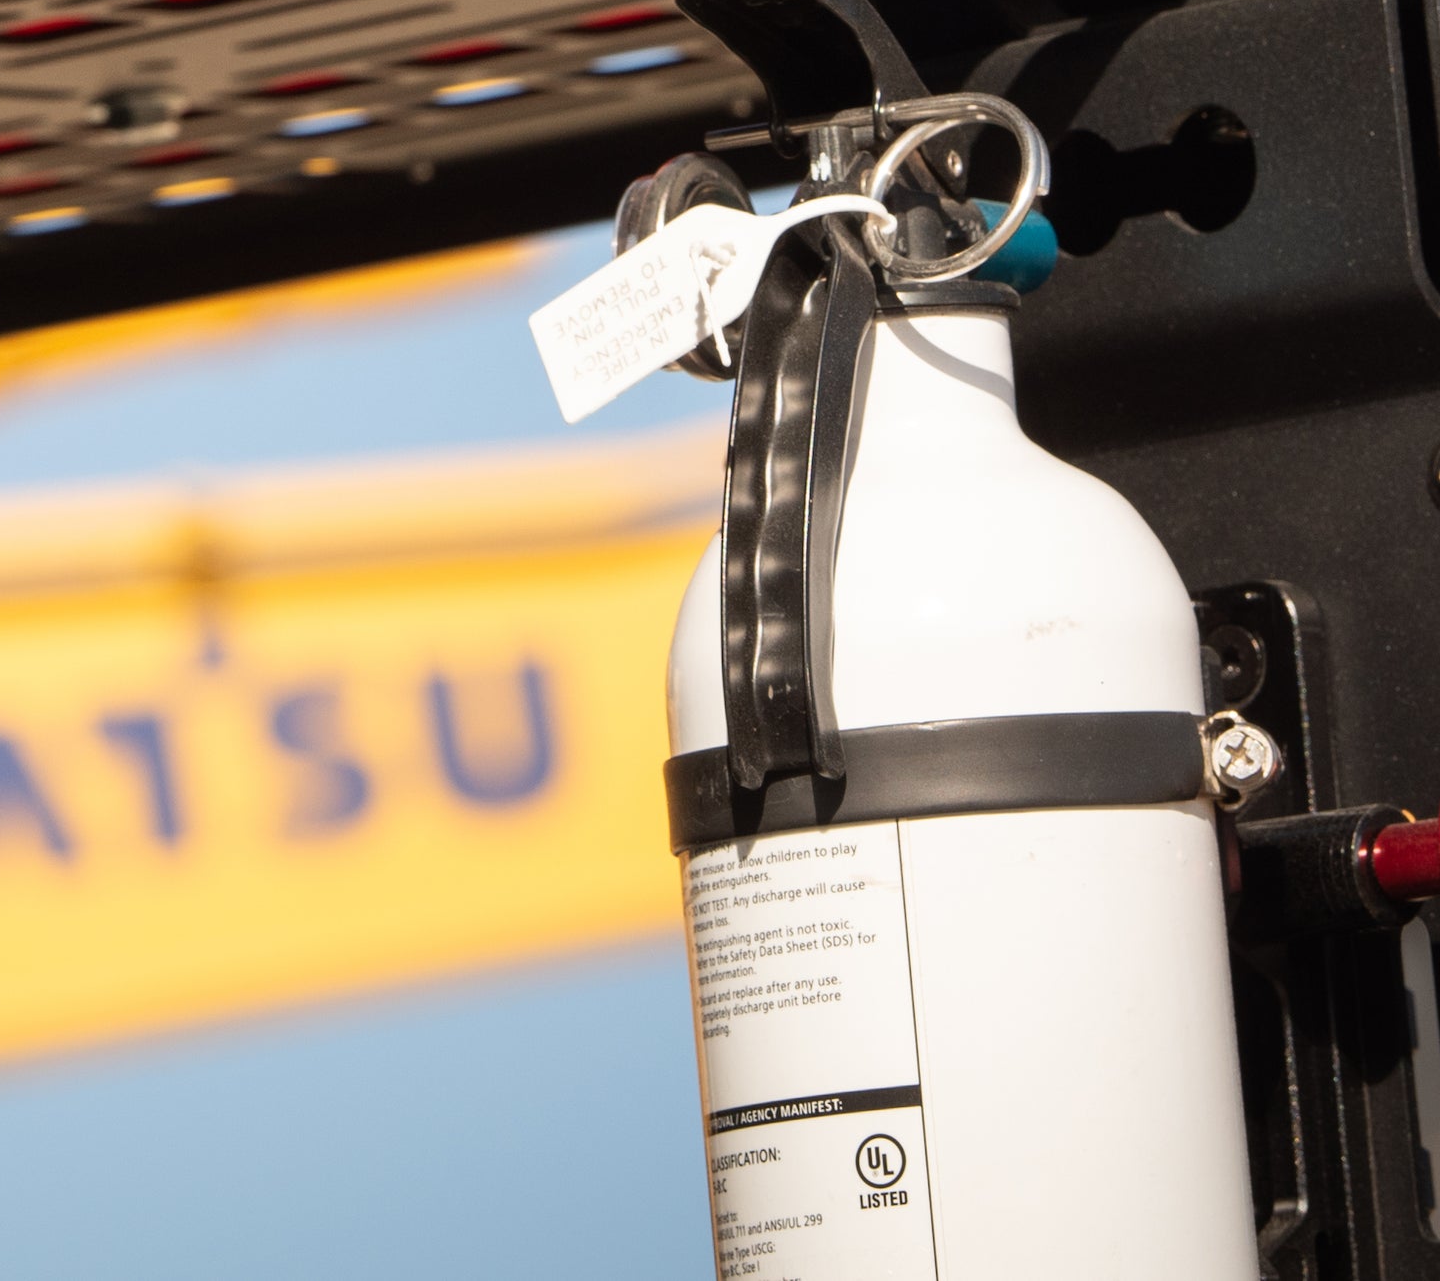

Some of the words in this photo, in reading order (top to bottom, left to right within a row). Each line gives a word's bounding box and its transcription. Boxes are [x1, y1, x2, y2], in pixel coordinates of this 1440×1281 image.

[555, 278, 632, 339] REMOVE
[610, 280, 661, 318] PULL
[573, 318, 605, 347] PIN
[573, 295, 685, 381] EMERGENCY
[601, 348, 641, 382] FIRE
[727, 860, 736, 871] or
[766, 849, 810, 864] children
[814, 847, 827, 857] to
[831, 843, 857, 857] play
[712, 871, 771, 892] extinguishers.
[712, 897, 731, 912] TEST.
[733, 895, 749, 908] Any
[752, 887, 802, 905] discharge
[805, 883, 826, 896] will
[830, 880, 865, 893] cause
[703, 933, 751, 952] extinguishing
[754, 928, 782, 944] agent
[785, 925, 794, 937] is
[797, 923, 816, 935] not
[820, 918, 854, 932] toxic.
[717, 952, 728, 965] the
[730, 948, 757, 964] Safety
[759, 945, 783, 957] Data
[786, 940, 818, 953] Sheet
[822, 933, 853, 950] (SDS)
[857, 932, 877, 944] for
[732, 984, 763, 1000] replace
[766, 980, 791, 994] after
[794, 978, 814, 990] any
[818, 975, 842, 987] use.
[732, 999, 774, 1016] discharge
[777, 995, 798, 1009] unit
[802, 990, 841, 1005] before
[740, 1107, 779, 1124] AGENCY
[780, 1098, 843, 1117] MANIFEST:
[860, 1190, 908, 1210] LISTED
[748, 1220, 762, 1235] and
[764, 1215, 801, 1232] ANSI/UL
[804, 1213, 823, 1227] 299
[735, 1245, 750, 1261] Type
[751, 1241, 776, 1257] USCG:
